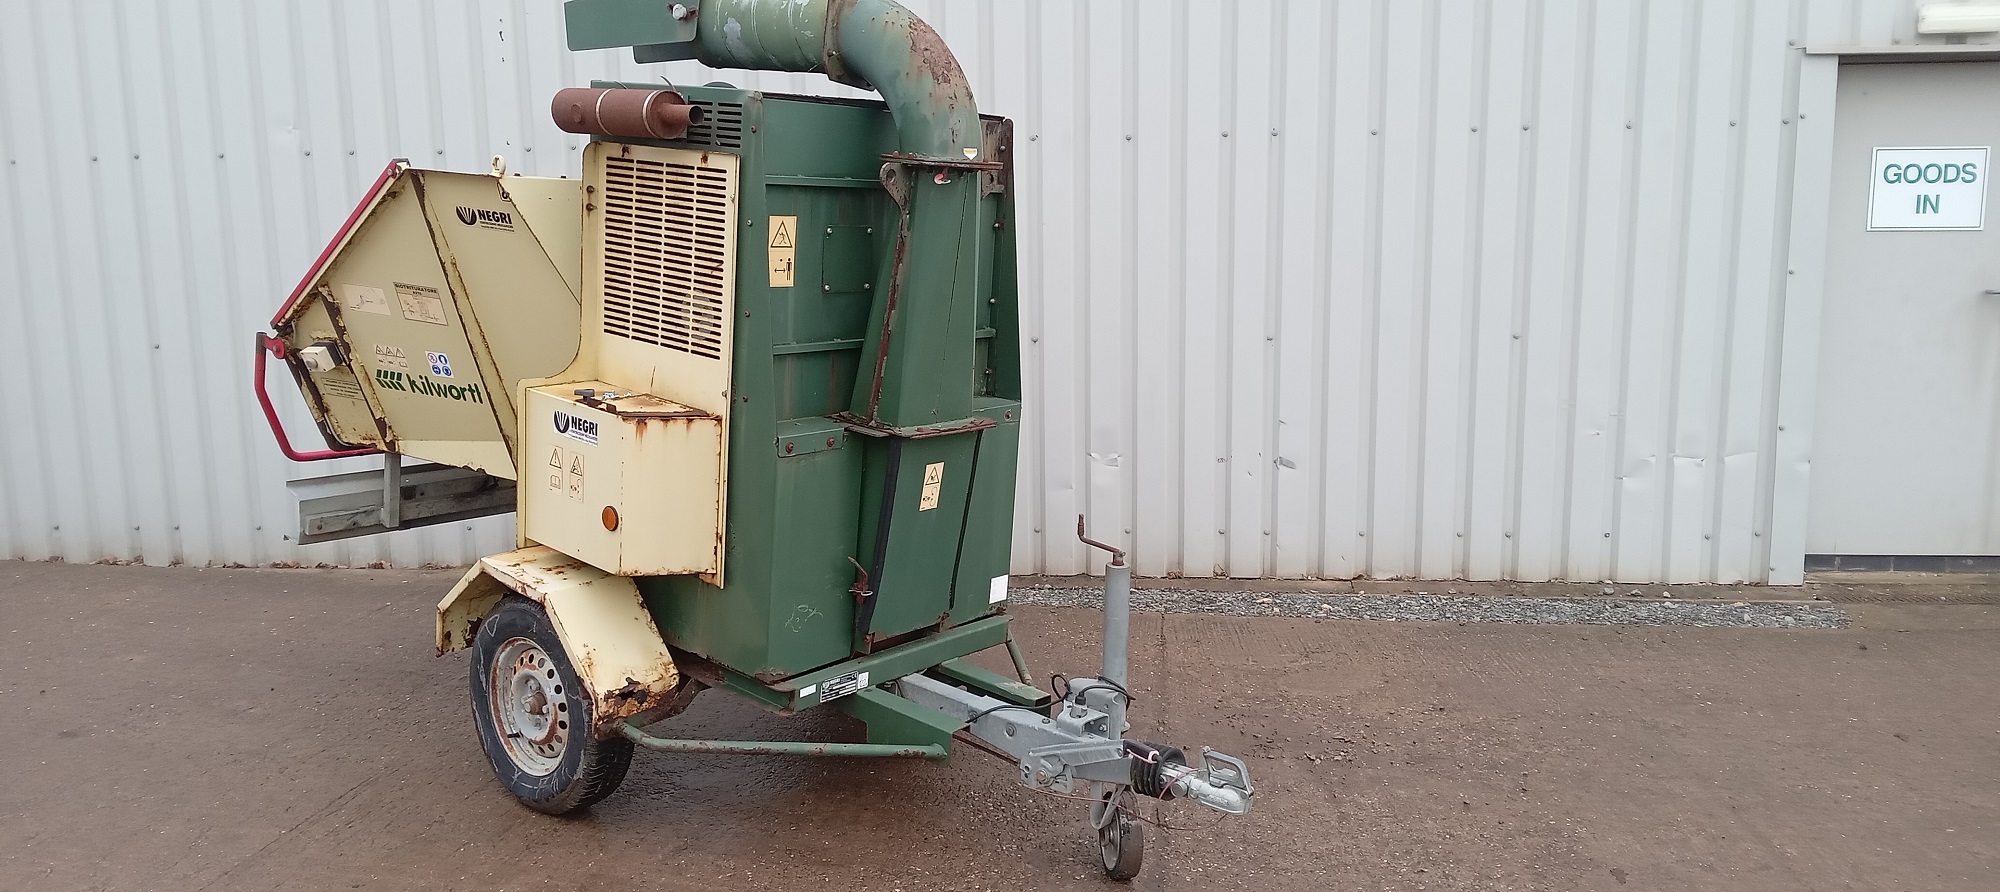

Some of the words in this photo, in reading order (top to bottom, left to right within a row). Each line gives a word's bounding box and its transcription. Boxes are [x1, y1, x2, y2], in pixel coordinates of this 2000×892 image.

[1883, 163, 1978, 184] GOODS
[1915, 194, 1941, 214] IN
[477, 208, 513, 225] NEGRI
[571, 415, 599, 437] NEGRI
